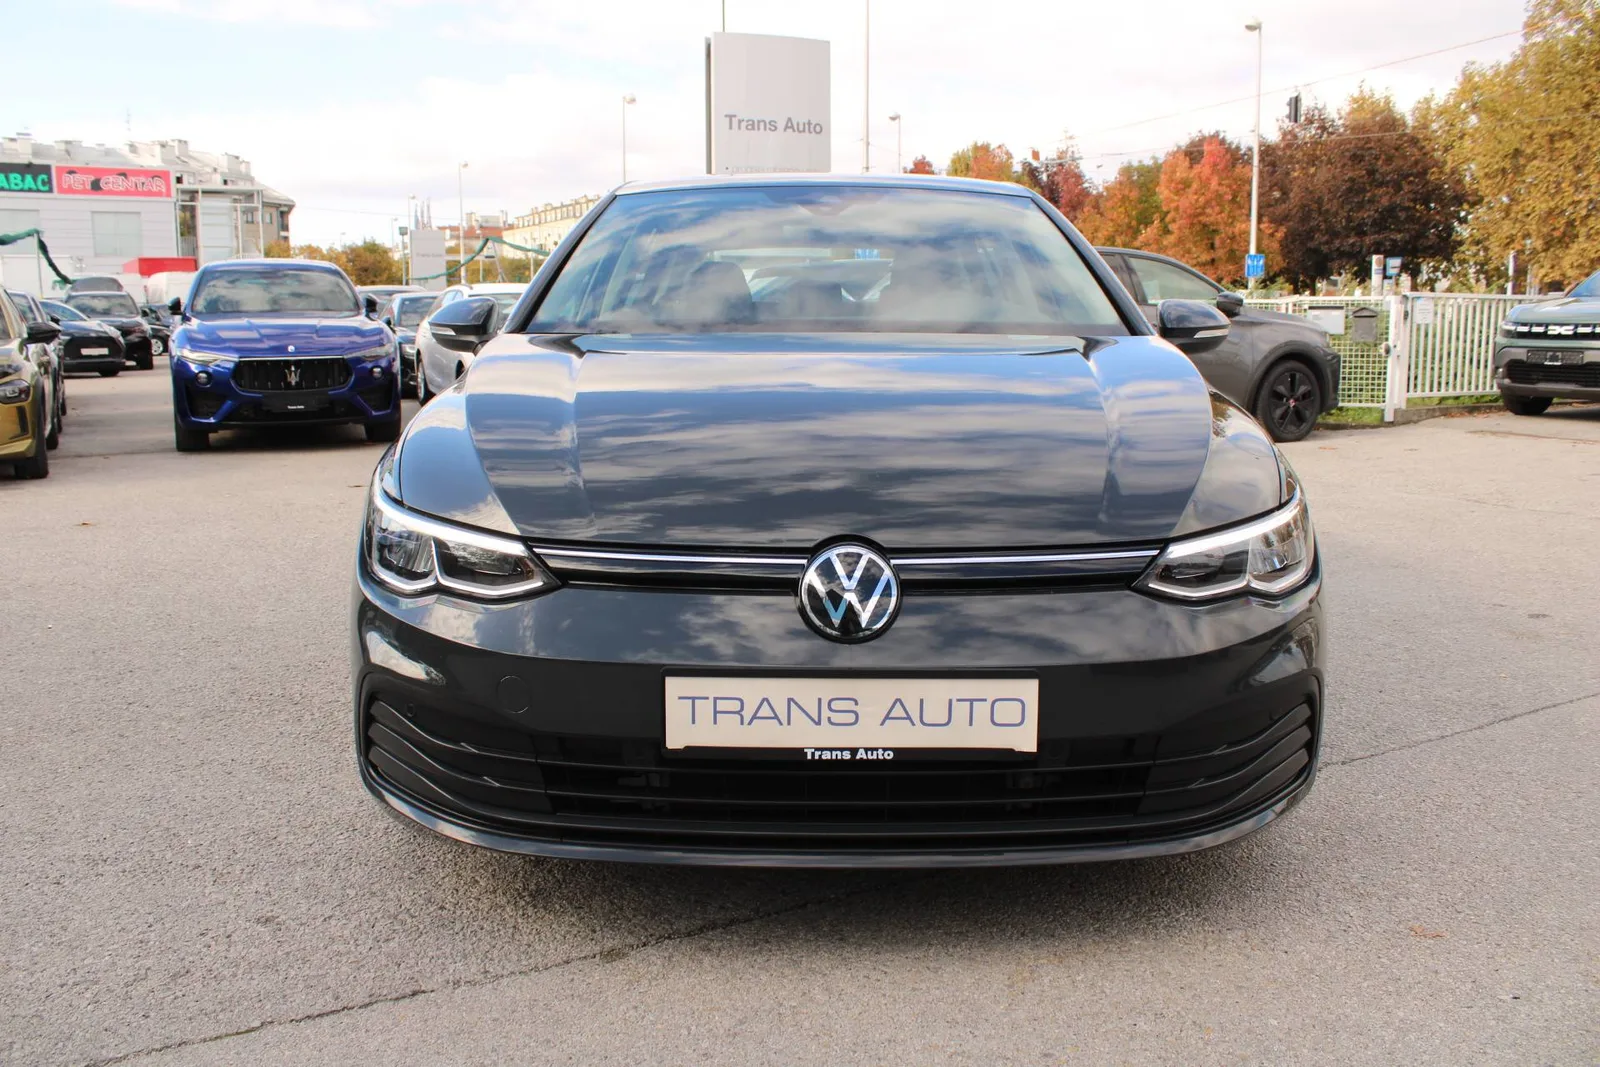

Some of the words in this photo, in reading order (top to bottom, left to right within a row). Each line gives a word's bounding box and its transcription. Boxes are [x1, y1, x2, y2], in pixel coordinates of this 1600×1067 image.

[724, 113, 778, 132] Trans
[783, 117, 823, 135] Auto
[62, 173, 94, 189] PET
[99, 175, 166, 193] CENTAR
[677, 696, 860, 727] TRANS
[879, 697, 1026, 728] AUTO
[803, 748, 851, 760] Trans
[855, 748, 894, 760] Auto
